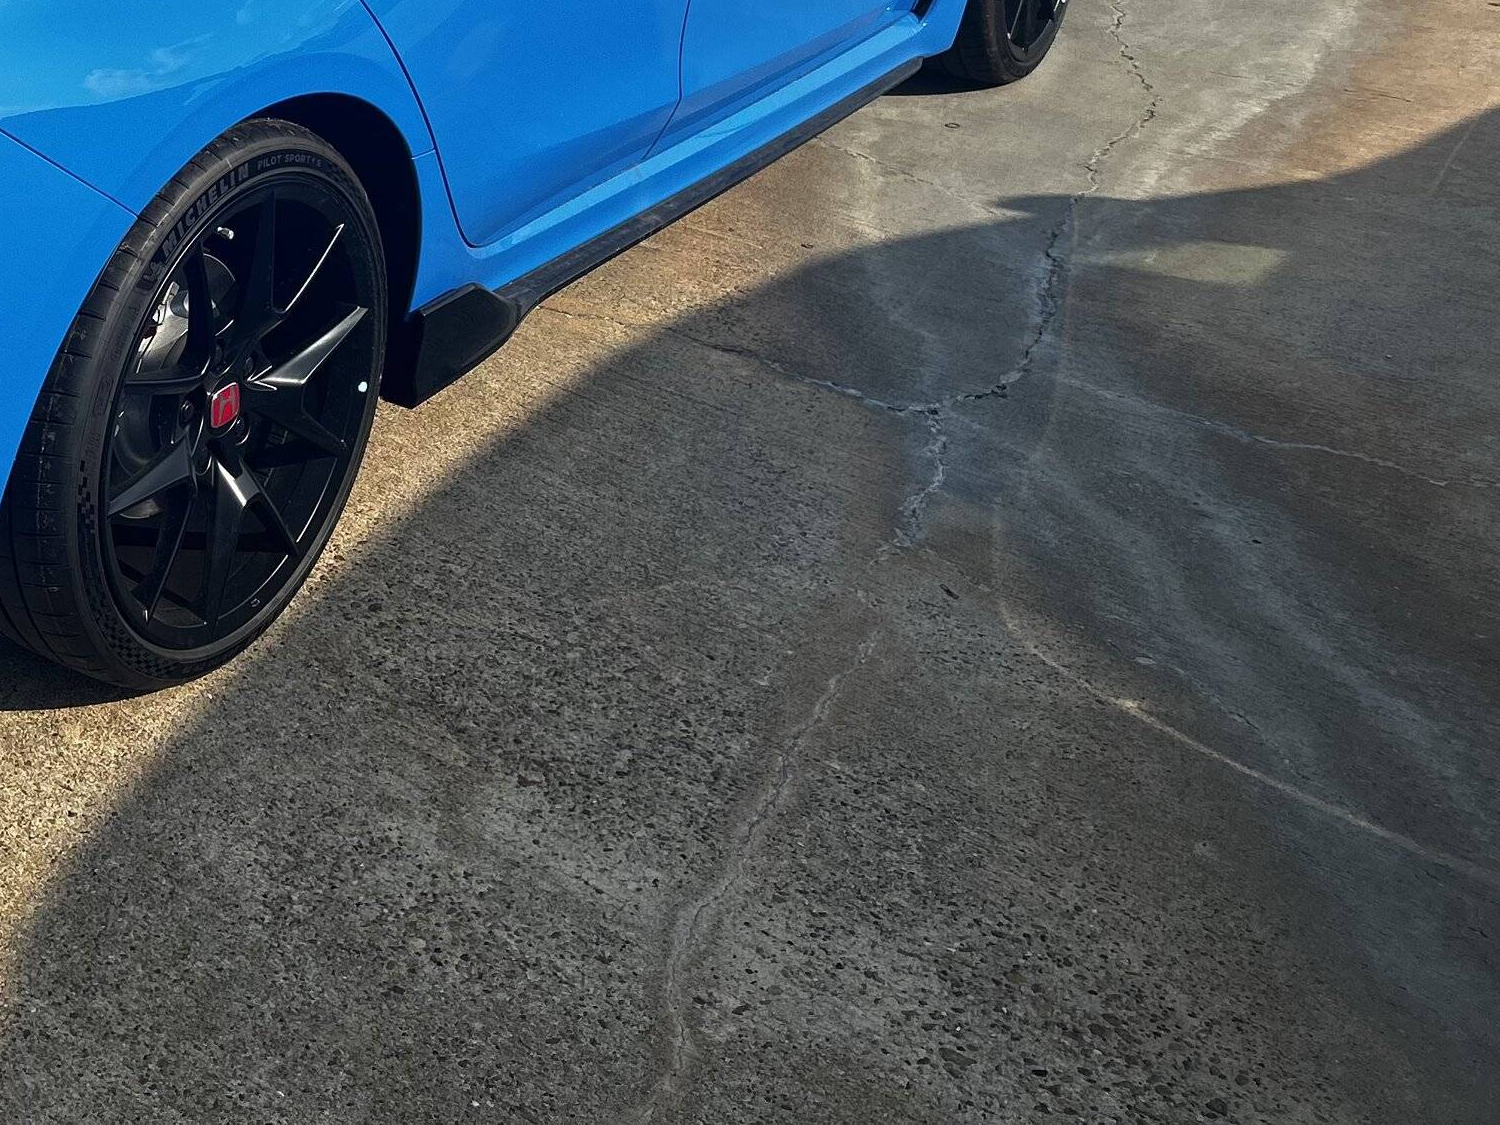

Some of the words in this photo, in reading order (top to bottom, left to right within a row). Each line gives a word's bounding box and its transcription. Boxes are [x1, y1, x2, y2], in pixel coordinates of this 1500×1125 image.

[257, 155, 283, 171] PILOT
[284, 153, 311, 165] SPORT
[162, 162, 250, 258] MICHELIN
